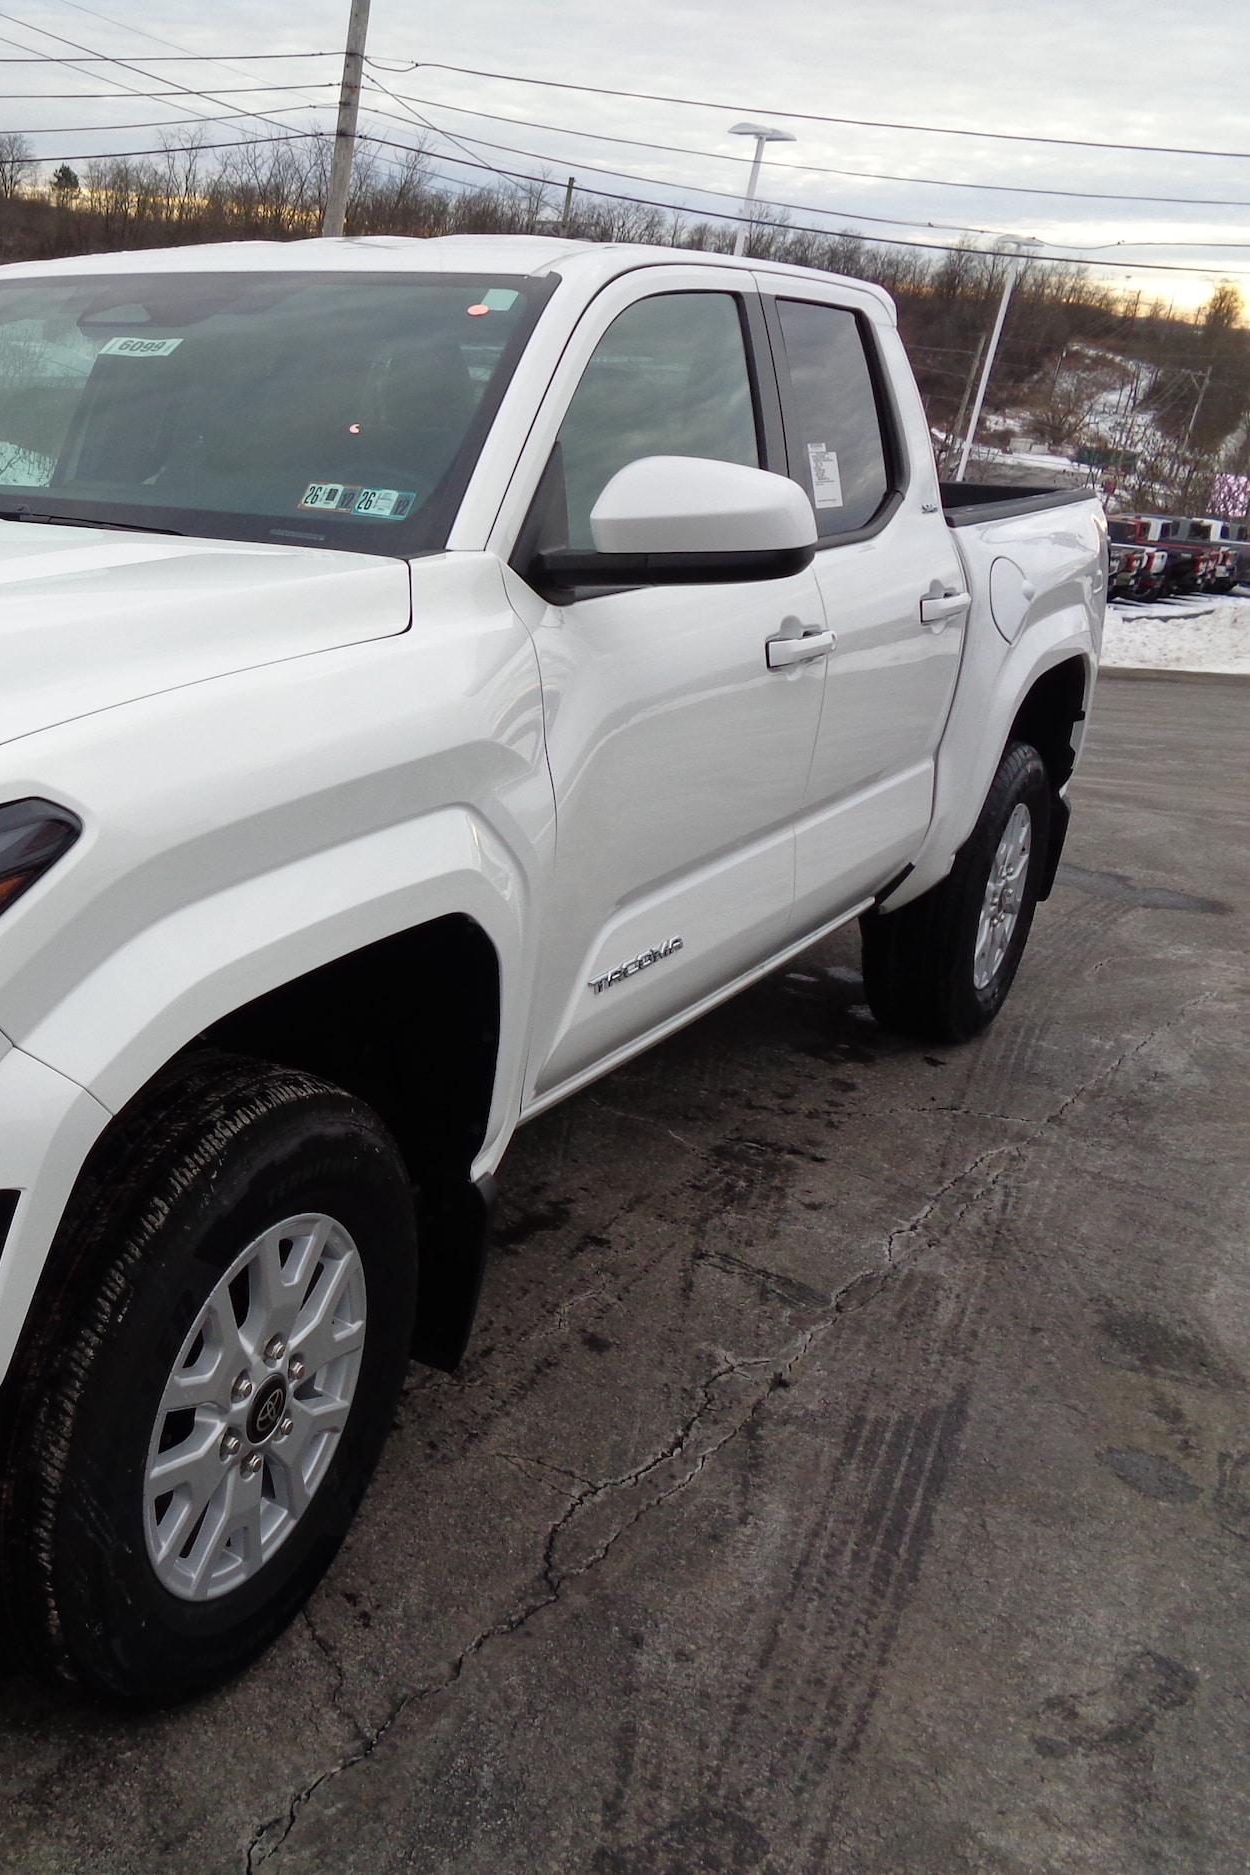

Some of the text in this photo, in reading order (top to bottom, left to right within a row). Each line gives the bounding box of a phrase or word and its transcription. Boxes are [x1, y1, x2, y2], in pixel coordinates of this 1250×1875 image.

[118, 340, 166, 352] 6099
[303, 486, 323, 505] 26
[339, 492, 355, 509] 12
[356, 491, 376, 511] 26
[394, 499, 410, 515] 12
[587, 934, 684, 995] TACOMA
